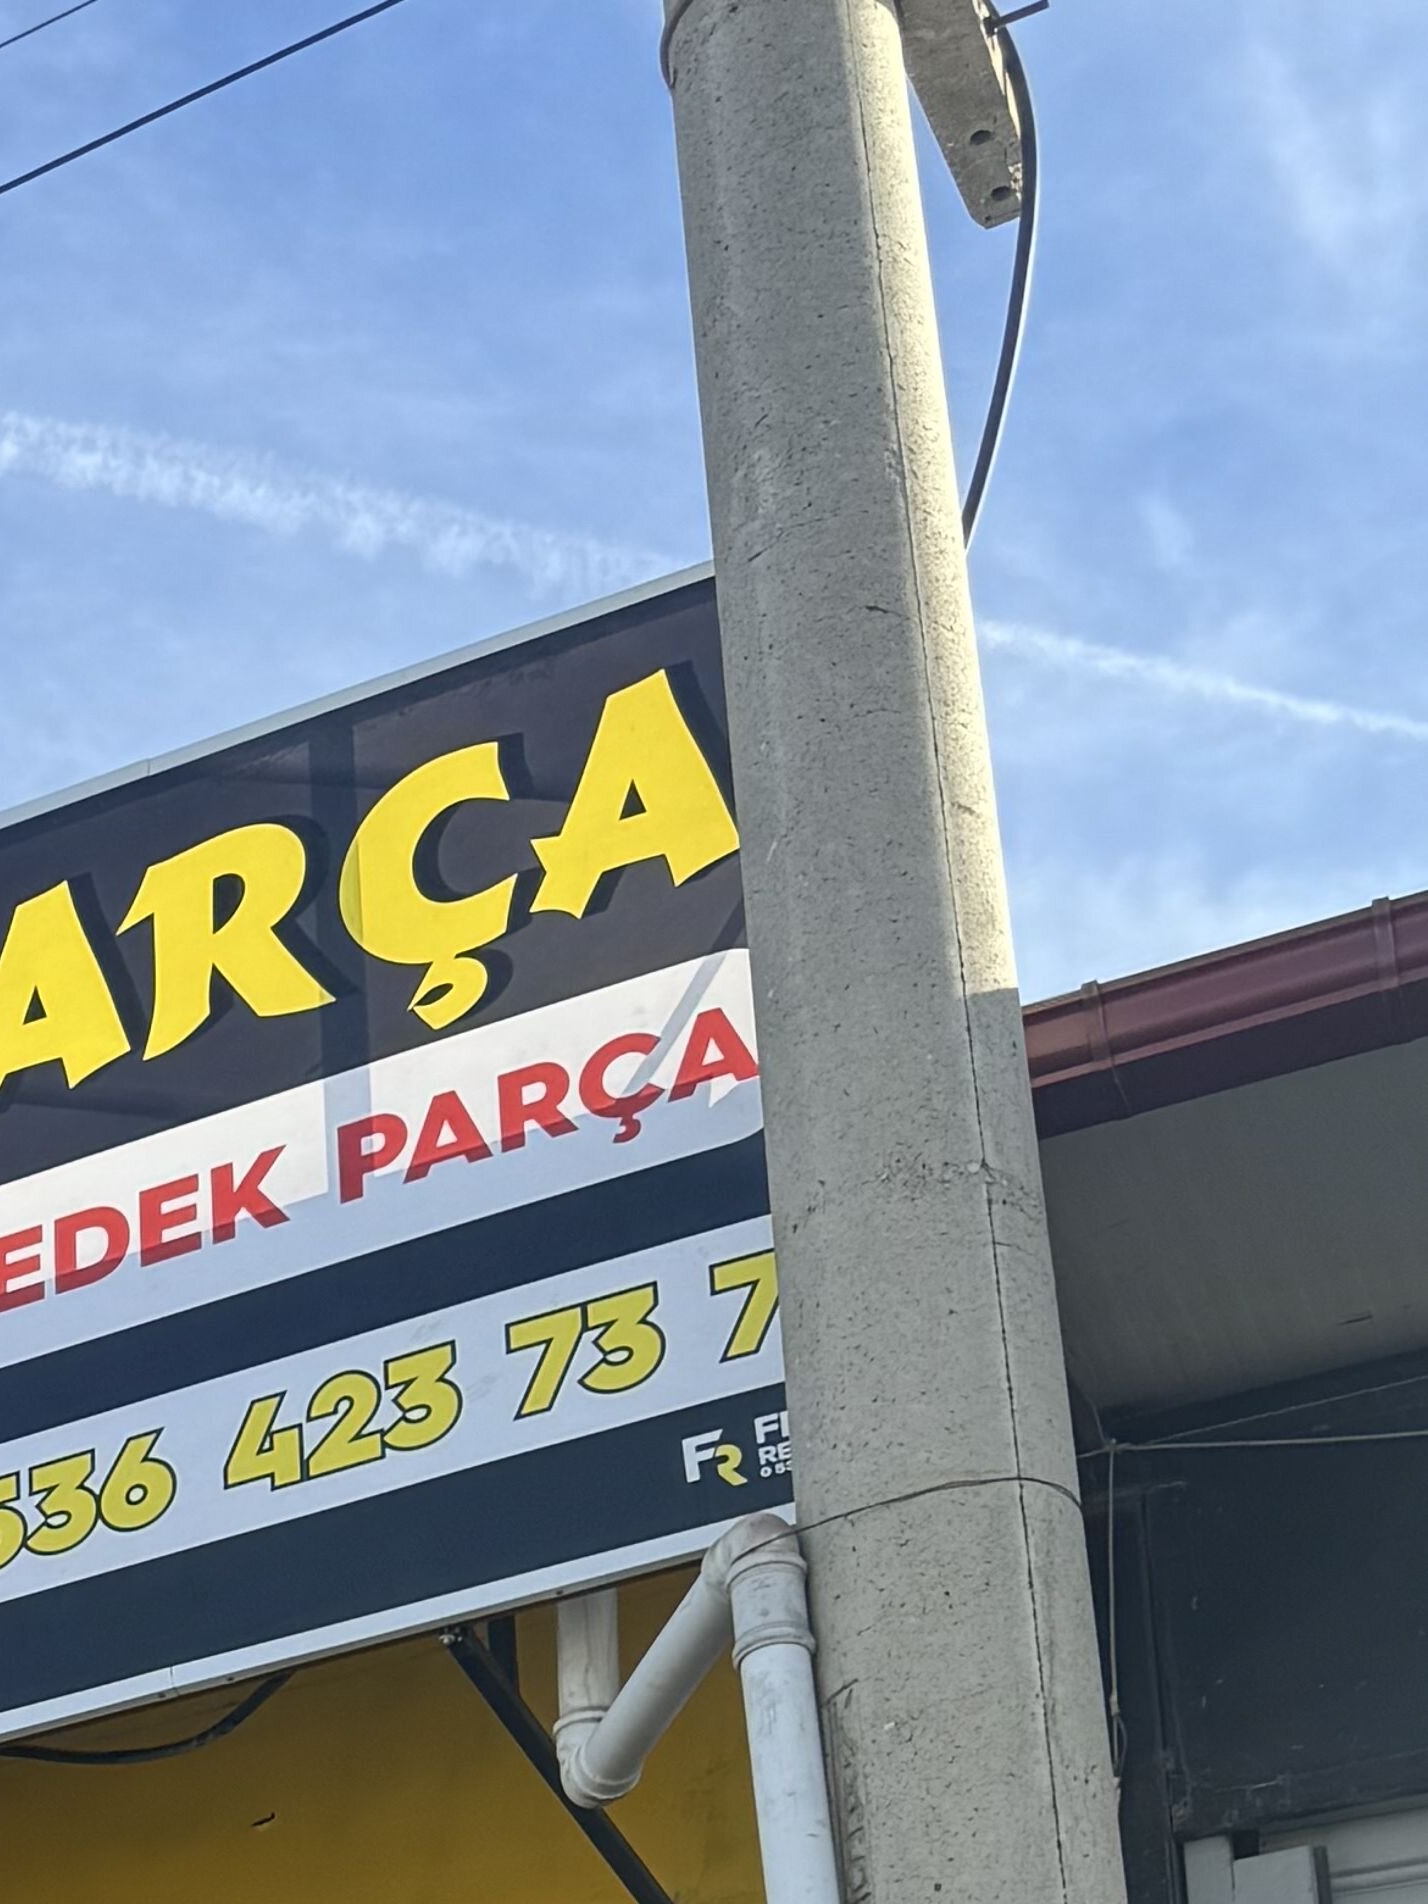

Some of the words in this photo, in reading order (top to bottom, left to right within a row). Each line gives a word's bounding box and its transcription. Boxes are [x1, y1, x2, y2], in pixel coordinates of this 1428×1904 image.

[337, 1008, 759, 1200] PARÇA
[224, 1339, 462, 1492] 423
[504, 1281, 667, 1414] 73
[708, 1248, 780, 1364] 7
